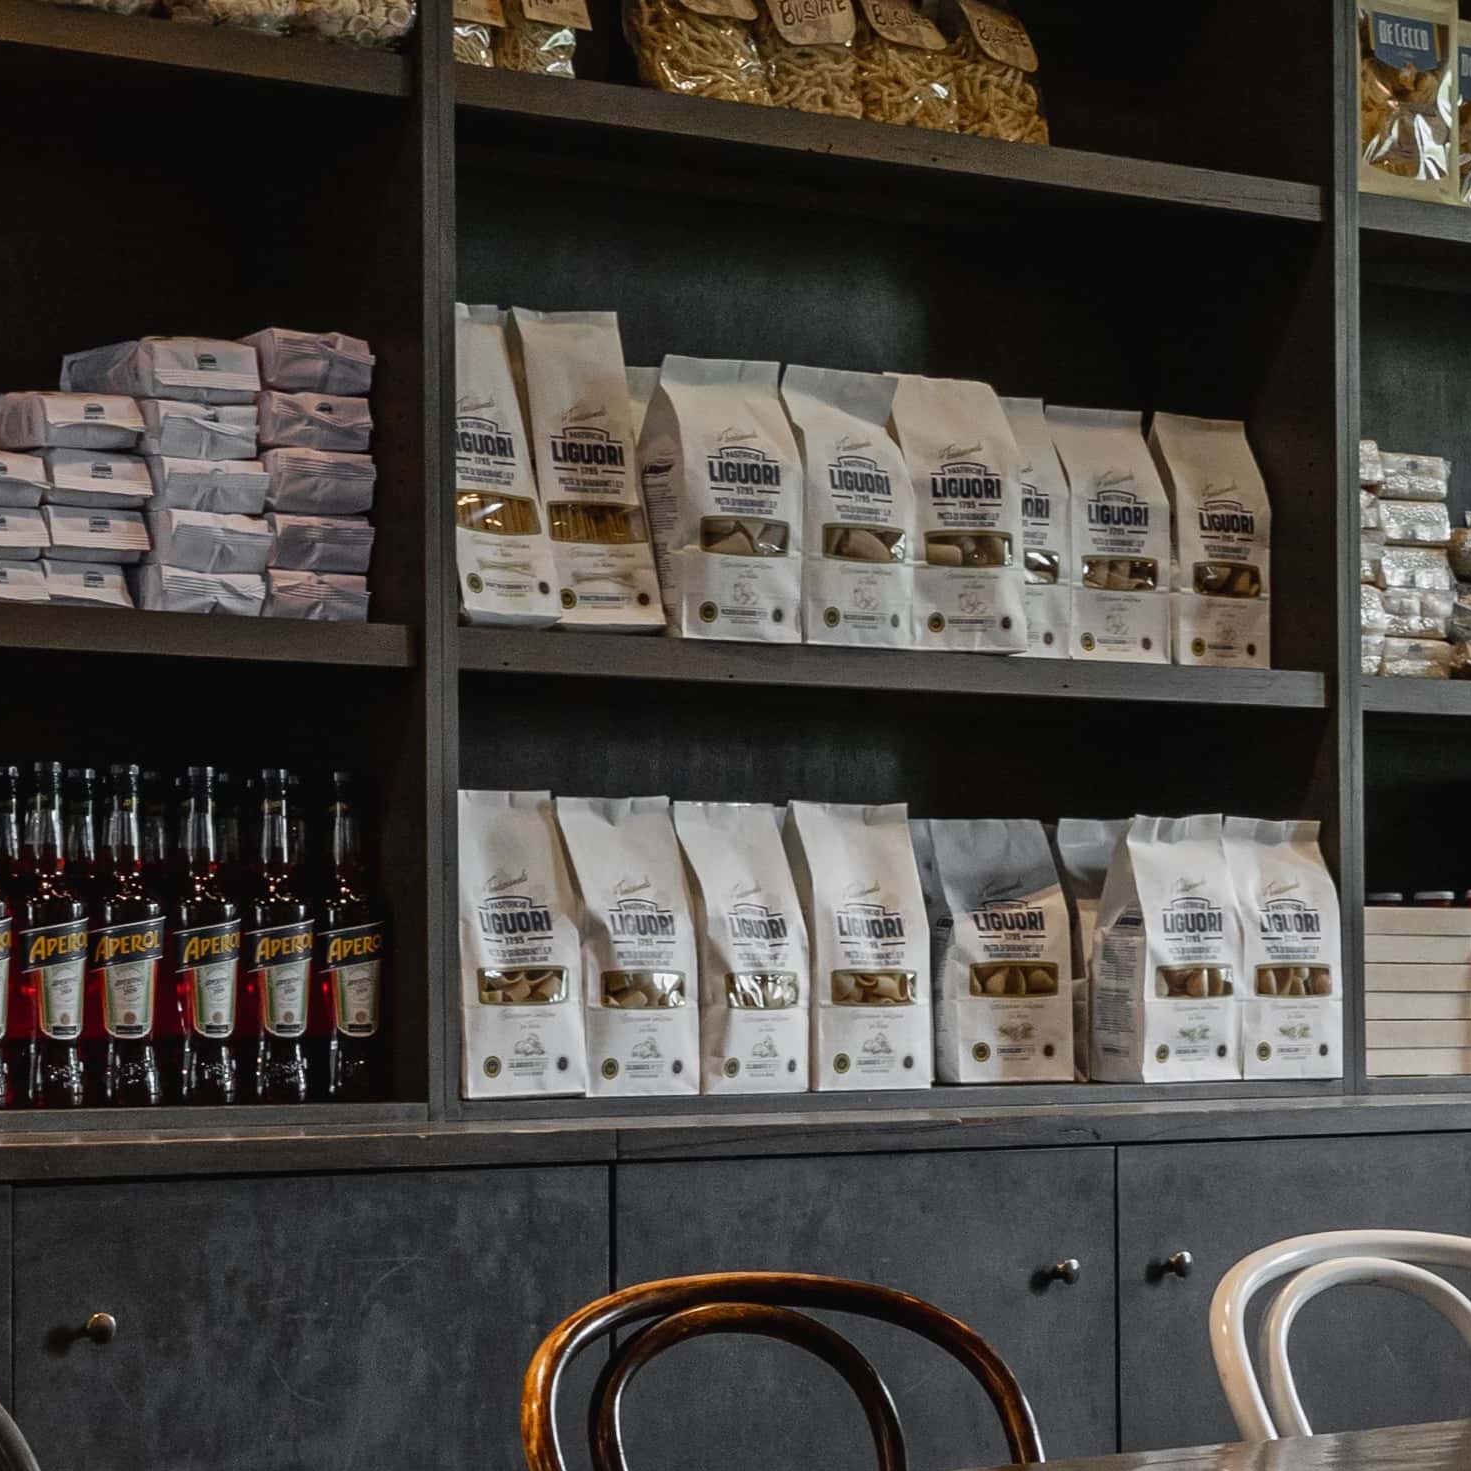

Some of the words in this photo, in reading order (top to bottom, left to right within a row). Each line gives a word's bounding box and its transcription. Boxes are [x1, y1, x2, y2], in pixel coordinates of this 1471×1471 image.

[551, 441, 625, 466] LIGUORI
[708, 460, 780, 486] LIGUORI
[829, 469, 892, 496] LIGUORI
[931, 477, 1002, 499] LIGUORI
[1088, 504, 1148, 526] LIGUORI
[1199, 512, 1254, 535] LIGUORI
[479, 911, 552, 935] LIGUORI
[610, 914, 676, 936] LIGUORI
[729, 917, 788, 939] LIGUORI
[837, 916, 906, 938] LIGUORI
[973, 911, 1045, 931] LIGUORI
[1162, 912, 1223, 933] LIGUORI
[1260, 913, 1320, 933] LIGUORI
[29, 931, 87, 964] APERO
[94, 930, 161, 964] APEROL
